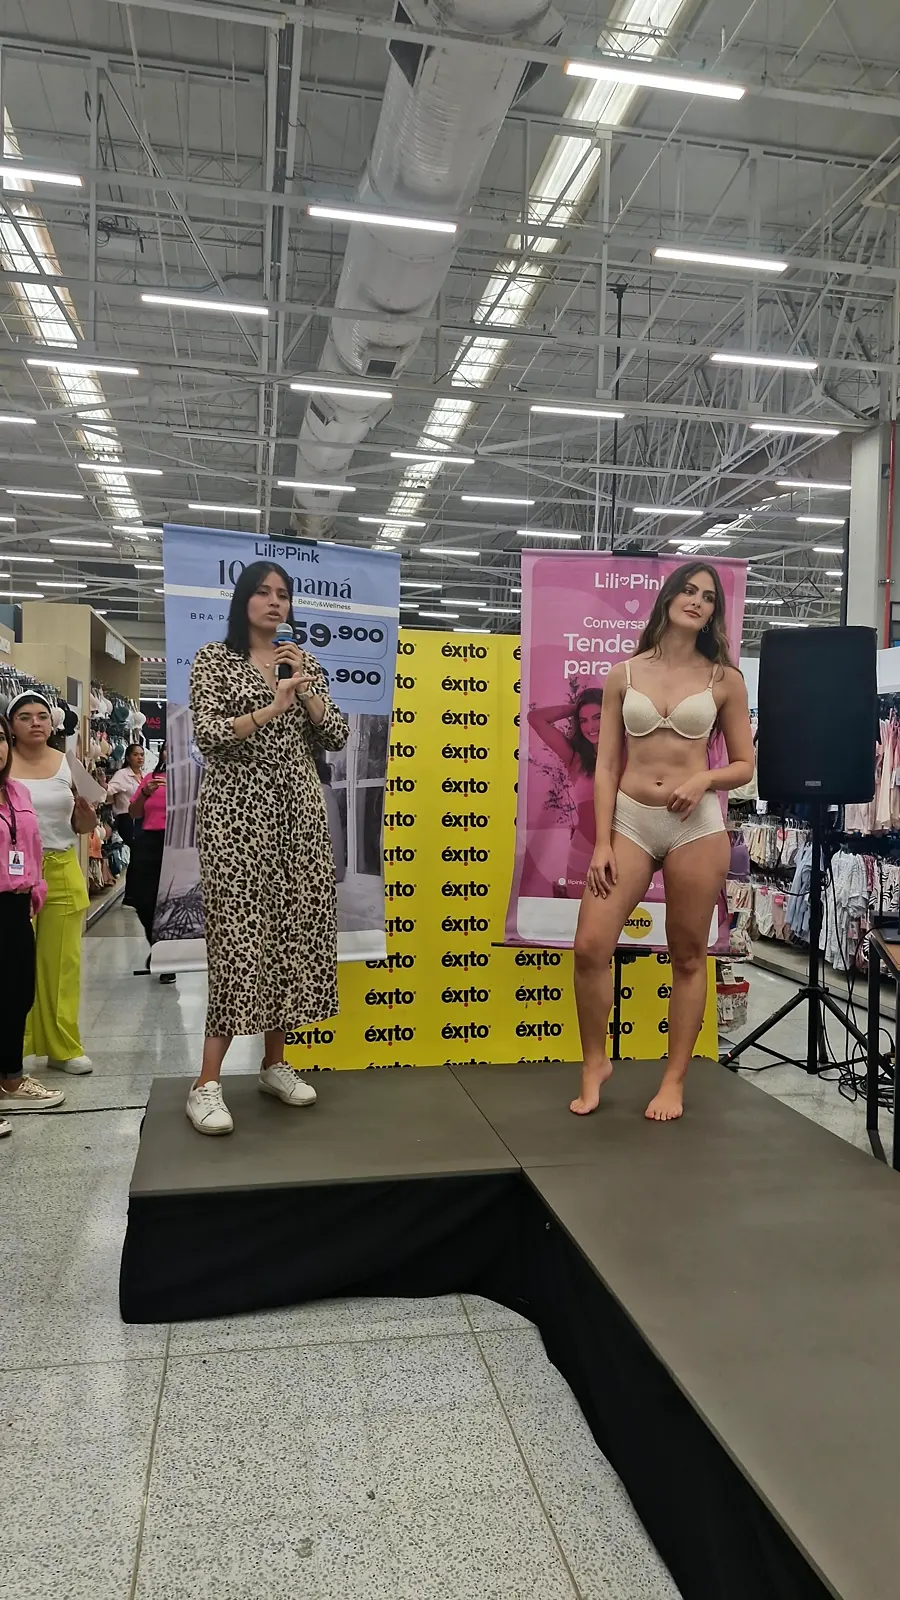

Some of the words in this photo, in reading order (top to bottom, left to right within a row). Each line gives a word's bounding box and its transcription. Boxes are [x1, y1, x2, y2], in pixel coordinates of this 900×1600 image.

[442, 642, 487, 662] éxito
[442, 676, 487, 695] éxito
[442, 710, 487, 729] éxito
[442, 744, 487, 763] éxito
[442, 778, 487, 797] éxito
[441, 812, 488, 832] éxito
[442, 846, 487, 866] éxito
[442, 881, 487, 901] éxito
[442, 916, 487, 936] éxito
[441, 951, 487, 971] éxito
[515, 951, 561, 970] éxito
[365, 988, 415, 1009] éxito
[442, 987, 487, 1007] éxito
[515, 985, 561, 1005] éxito
[365, 1025, 414, 1046] éxito
[441, 1022, 487, 1043] éxito
[516, 1021, 562, 1041] éxito
